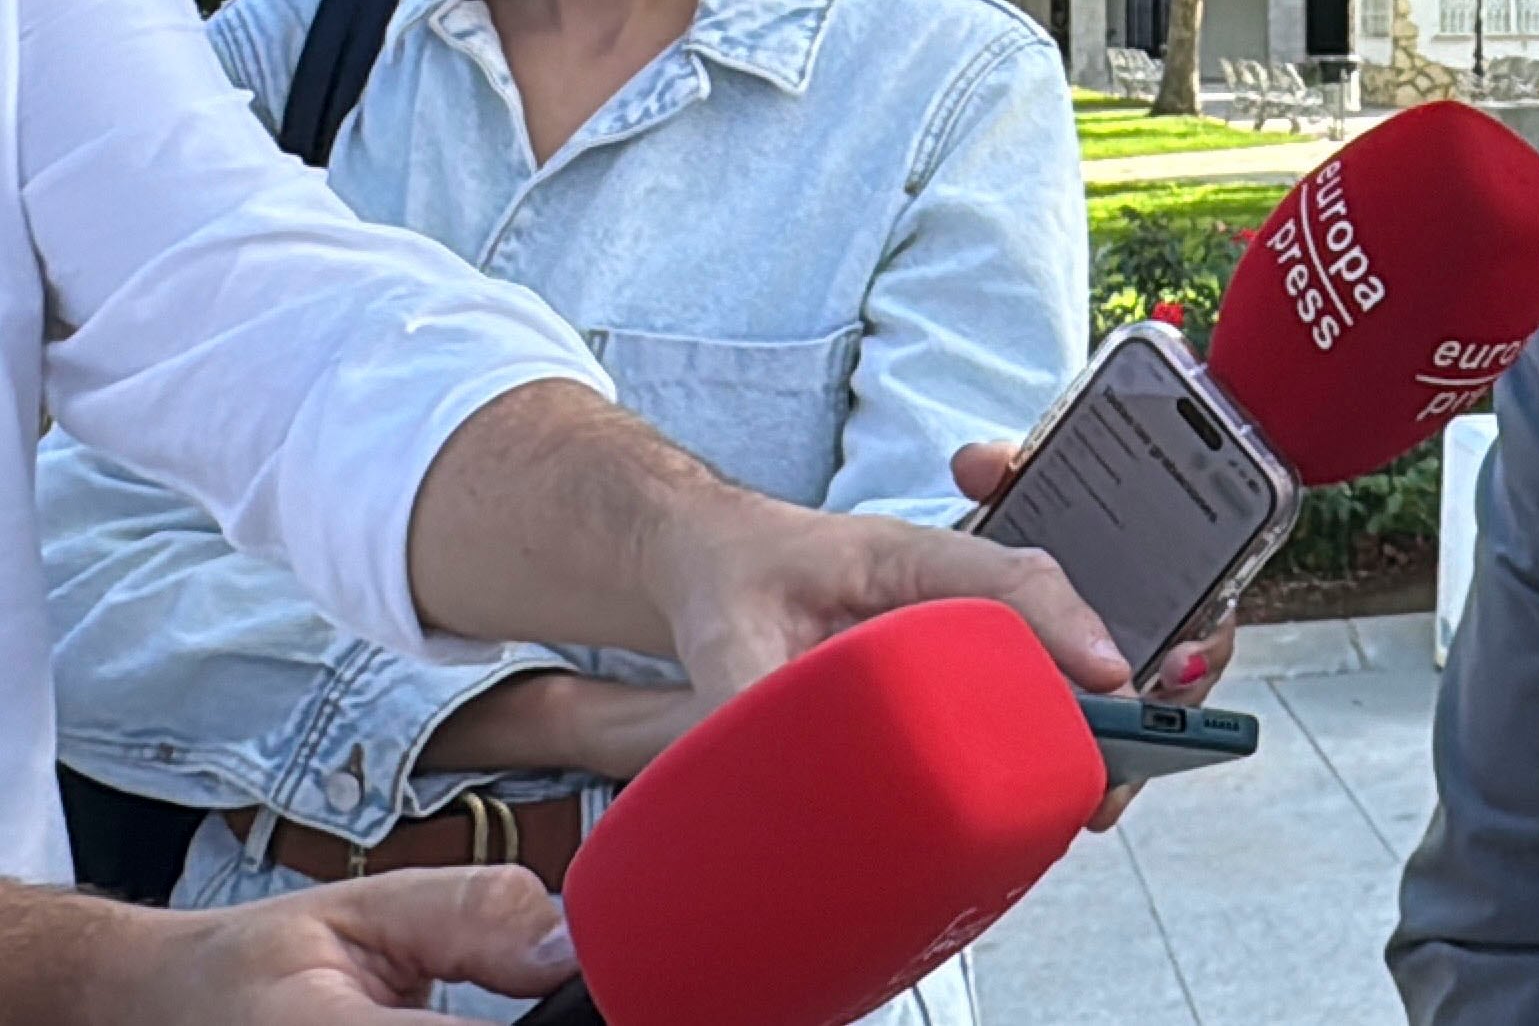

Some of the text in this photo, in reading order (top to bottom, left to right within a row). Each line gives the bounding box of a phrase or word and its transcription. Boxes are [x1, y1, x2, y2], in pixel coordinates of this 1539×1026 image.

[1316, 160, 1386, 312] europa
[1265, 218, 1340, 350] press
[1433, 340, 1522, 369] euro
[1415, 385, 1489, 421] pr
